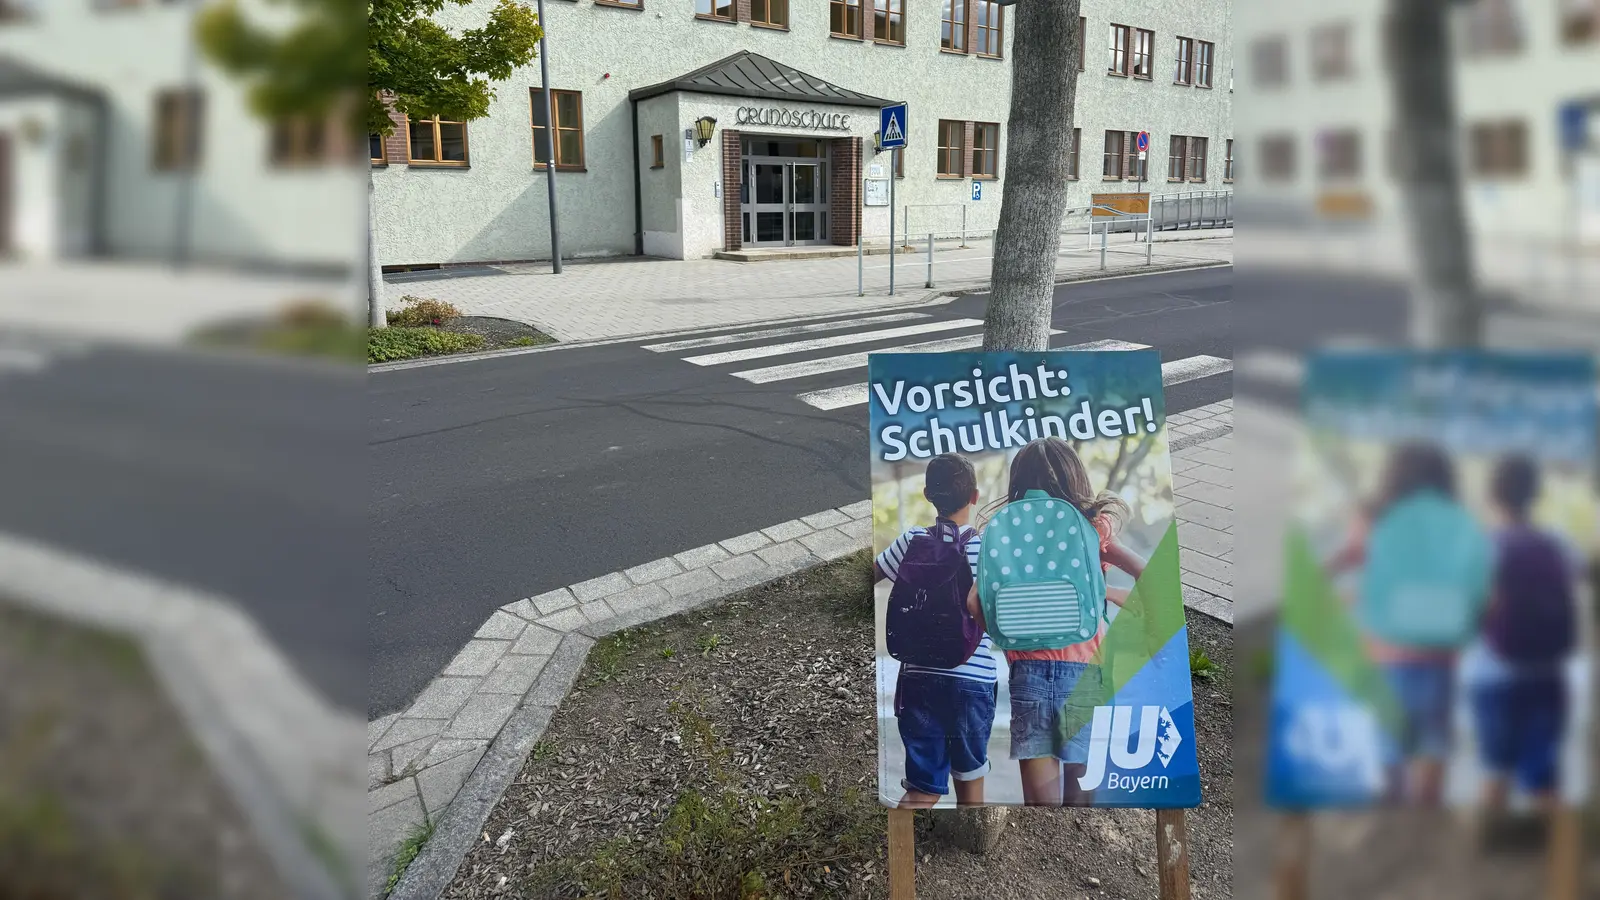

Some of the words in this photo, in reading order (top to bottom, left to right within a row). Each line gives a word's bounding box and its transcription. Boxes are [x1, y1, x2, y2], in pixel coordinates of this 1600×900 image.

[736, 106, 851, 132] GRUNDSCHULE
[973, 183, 980, 198] P
[873, 363, 1071, 416] Vorsicht:
[881, 397, 1157, 461] Schulkinder!
[1077, 706, 1160, 791] JU
[1107, 773, 1168, 793] Bayern
